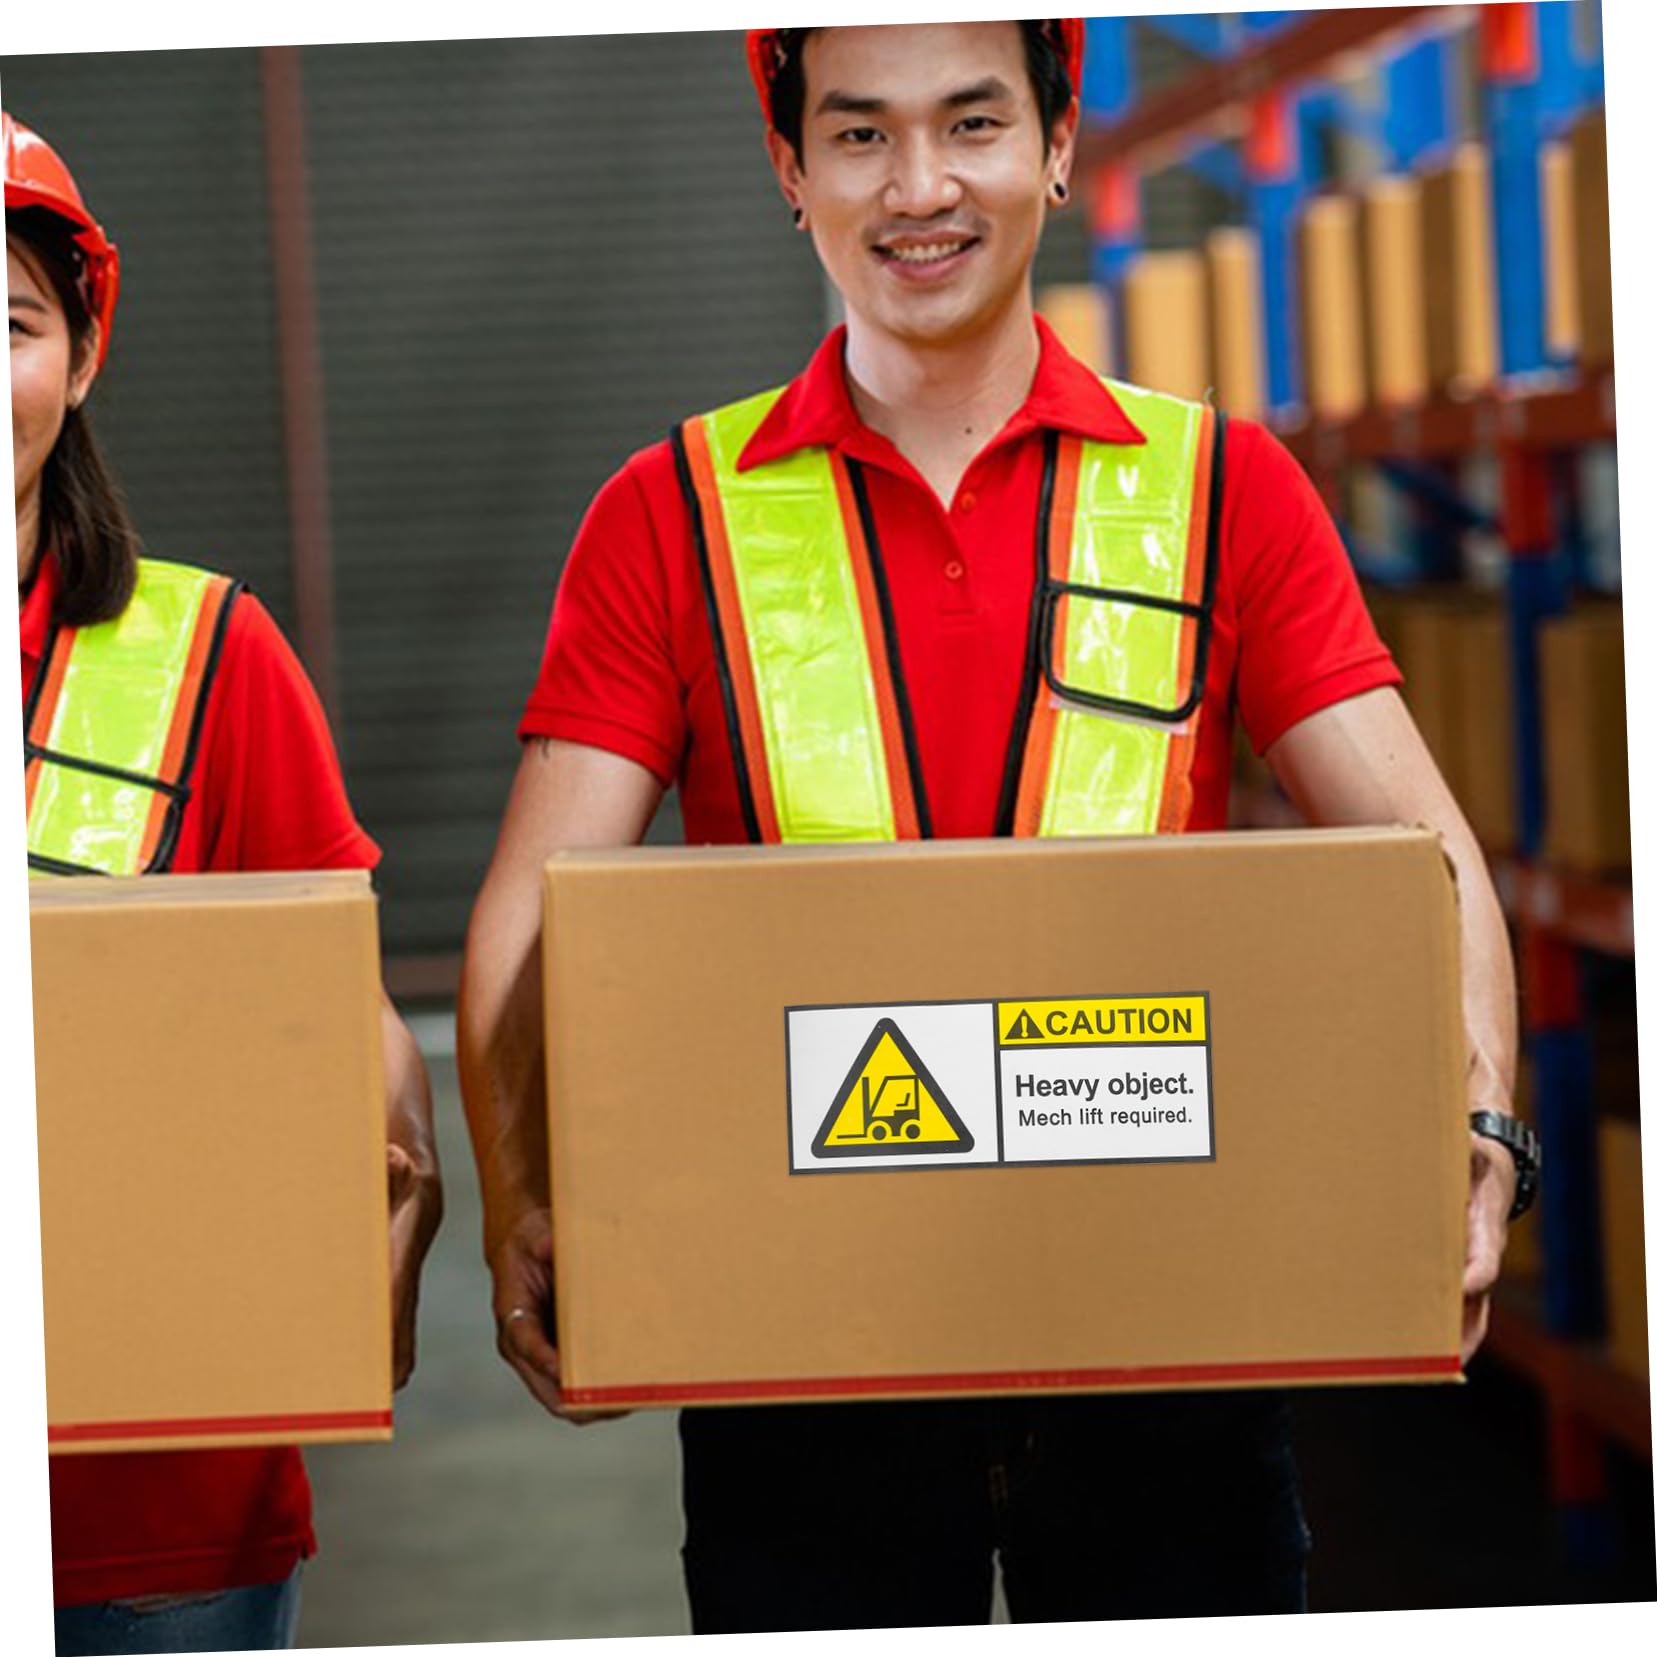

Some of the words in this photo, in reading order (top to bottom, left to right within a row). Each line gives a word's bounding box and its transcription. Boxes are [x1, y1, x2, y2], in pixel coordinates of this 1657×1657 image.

[1046, 1007, 1193, 1036] CAUTION
[1015, 1074, 1100, 1102] Heavy
[1107, 1071, 1195, 1099] object.
[1018, 1108, 1073, 1127] Mech
[1079, 1107, 1104, 1126] lift
[1110, 1106, 1193, 1126] required.
